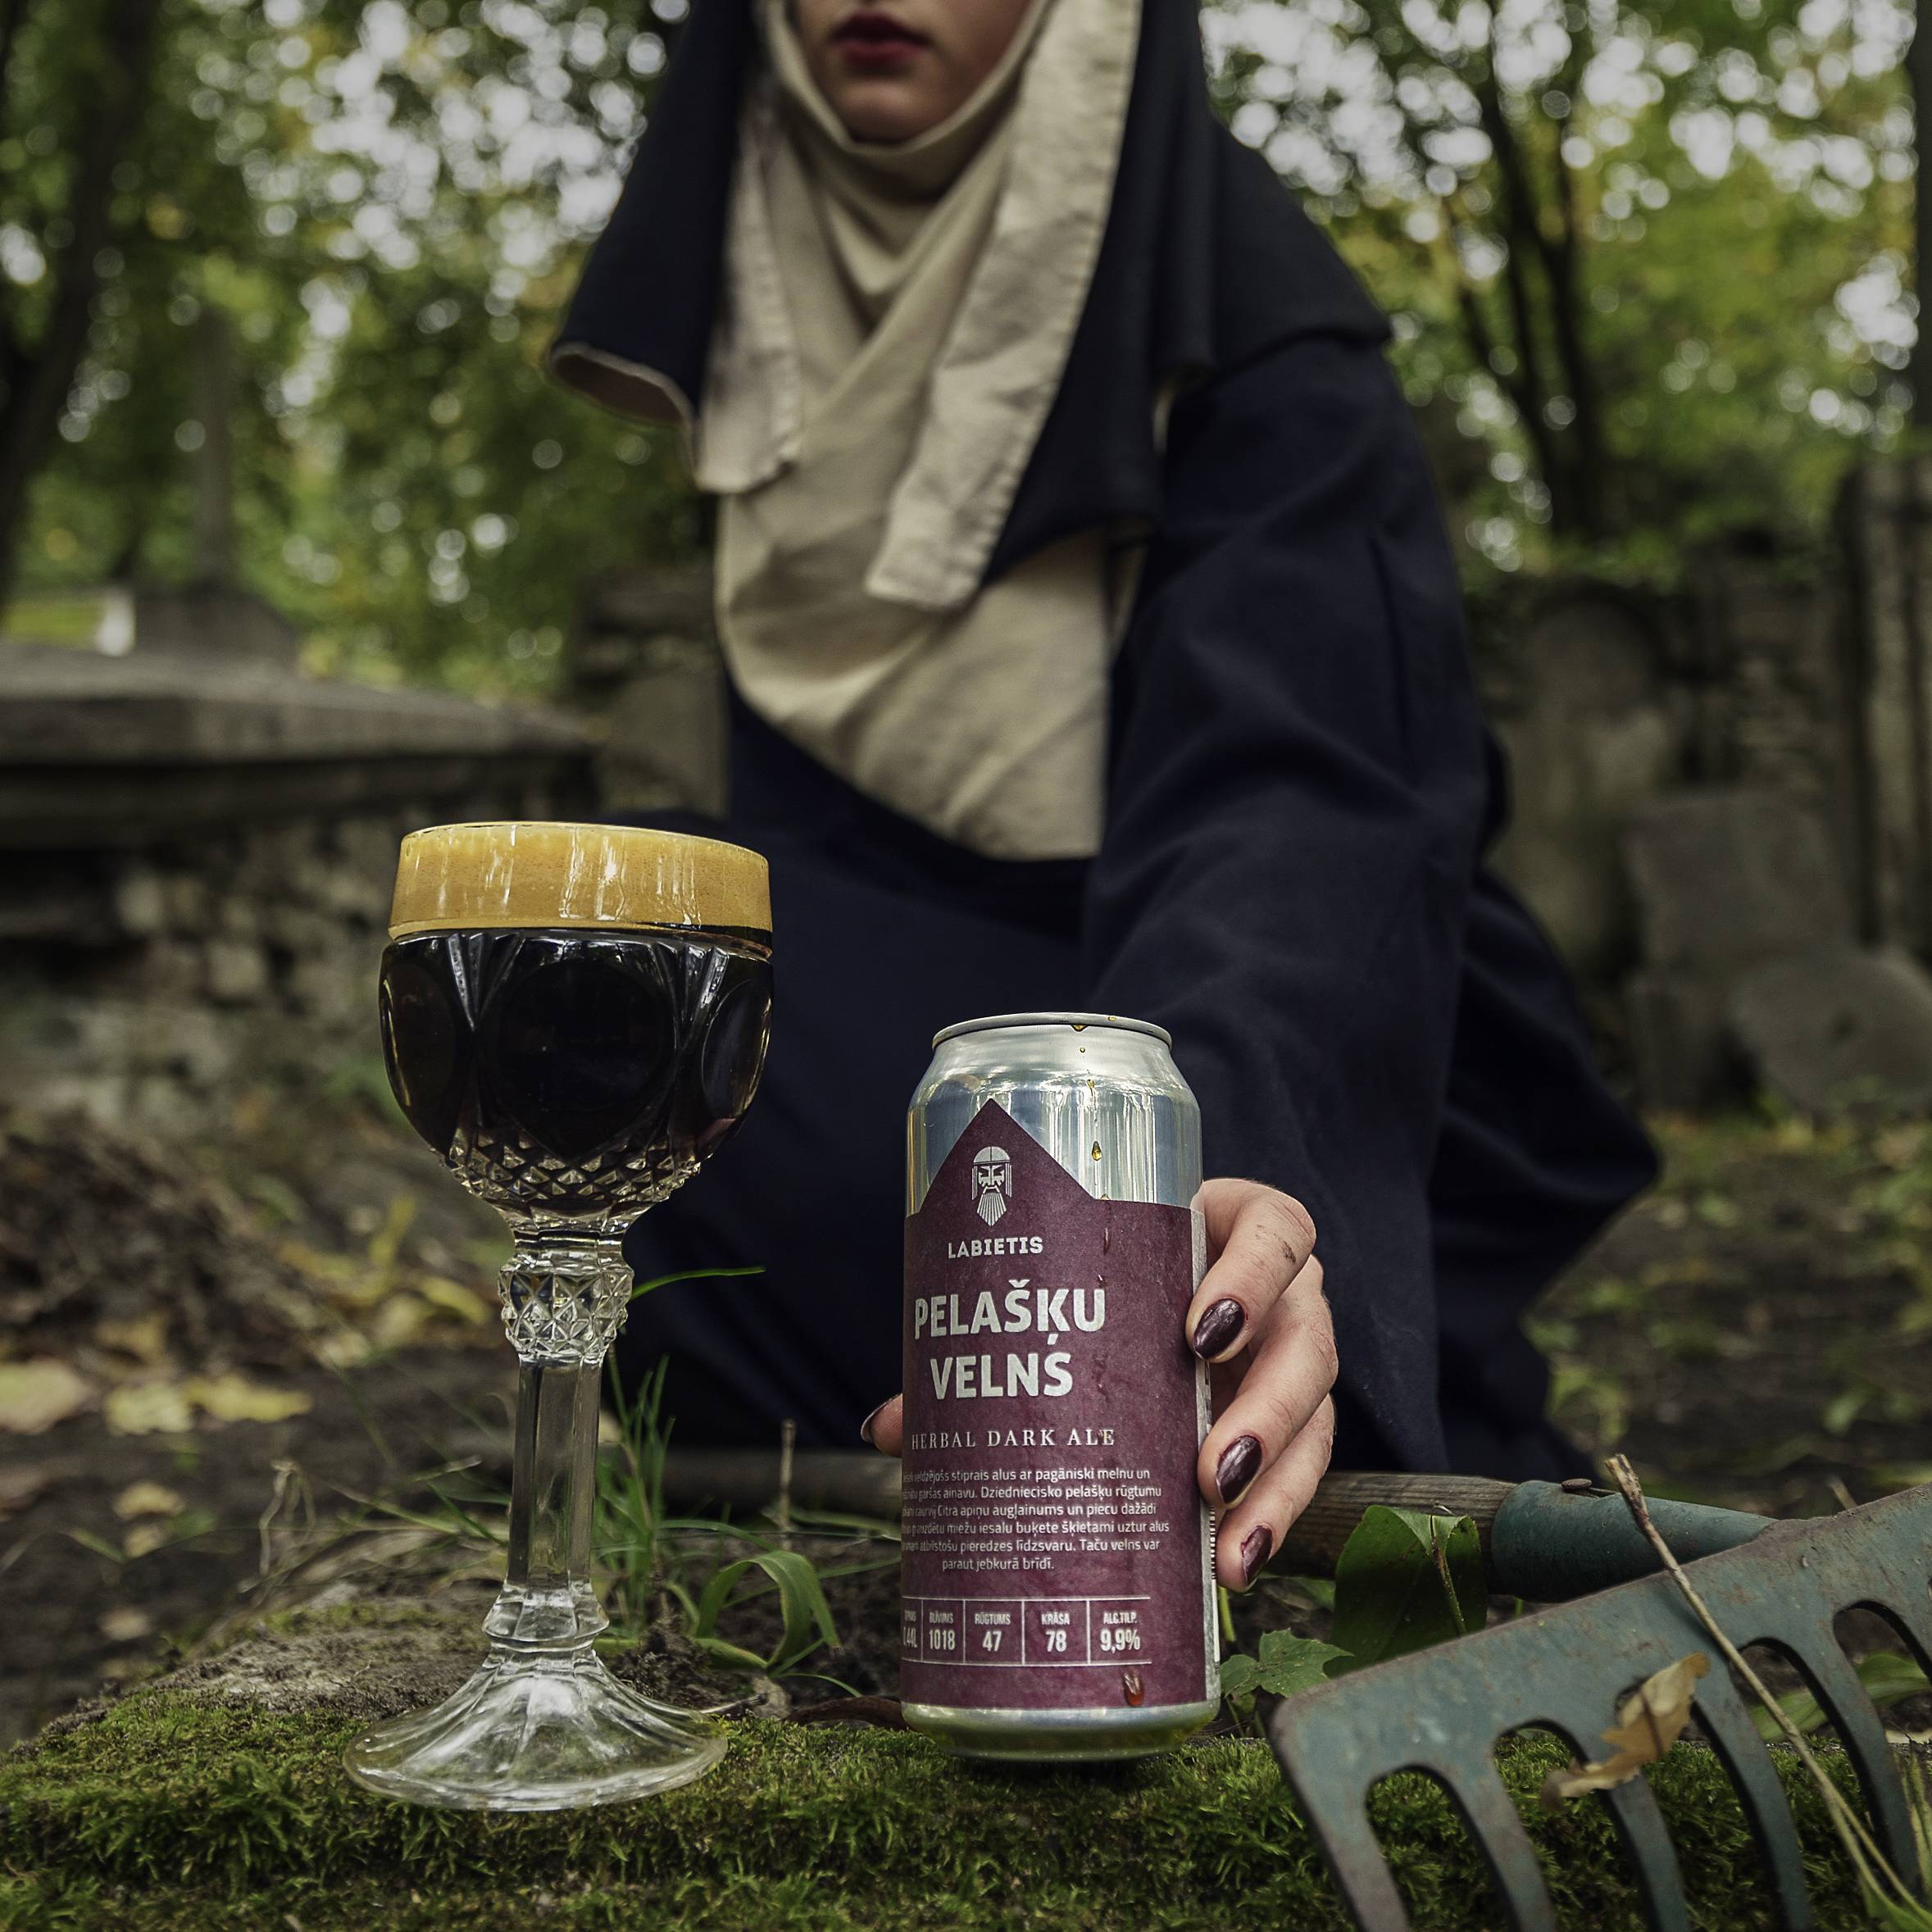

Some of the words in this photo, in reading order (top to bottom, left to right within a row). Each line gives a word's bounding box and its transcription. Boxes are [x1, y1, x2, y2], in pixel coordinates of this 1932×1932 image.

[948, 1236, 1043, 1258] LABIETIS
[915, 1280, 1106, 1345] PELAŠĶU
[930, 1352, 1073, 1399] VELNS
[911, 1432, 975, 1450] HERBAL
[988, 1430, 1056, 1447] DARK
[1067, 1429, 1115, 1446] ALE
[952, 1469, 989, 1483] stiprais
[992, 1468, 1016, 1481] alus
[1020, 1471, 1032, 1480] ar
[1035, 1467, 1094, 1483] pagāniski
[1098, 1467, 1133, 1480] melnu
[1136, 1470, 1150, 1480] un
[943, 1487, 978, 1499] ainavu.
[981, 1486, 1062, 1498] Dziedniecisko
[1066, 1485, 1112, 1502] pelašķu
[1116, 1486, 1161, 1500] rūgtumu
[938, 1504, 958, 1516] Citra
[960, 1505, 989, 1520] apiņu
[993, 1503, 1064, 1520] augļainums
[1067, 1505, 1083, 1516] un
[1086, 1503, 1117, 1517] piecu
[1121, 1502, 1156, 1515] dažādi
[947, 1521, 976, 1534] miežu
[980, 1521, 1013, 1534] iesalu
[1016, 1521, 1058, 1535] buķete
[1061, 1521, 1114, 1535] šķietami
[1117, 1521, 1146, 1533] uztur
[1149, 1521, 1170, 1532] alus
[960, 1539, 1013, 1553] pieredzes
[1016, 1539, 1075, 1552] līdzsvaru.
[1080, 1539, 1108, 1551] Taču
[1111, 1539, 1141, 1550] velns
[1143, 1539, 1159, 1550] var
[943, 1558, 974, 1572] paraut
[975, 1557, 1019, 1571] jebkurā
[1022, 1557, 1054, 1570] brīdī.
[1042, 1611, 1070, 1625] KRĀSA
[930, 1630, 955, 1651] 1018
[983, 1630, 1002, 1652] 47
[1046, 1630, 1066, 1652] 78
[1100, 1629, 1140, 1652] 9,9%
